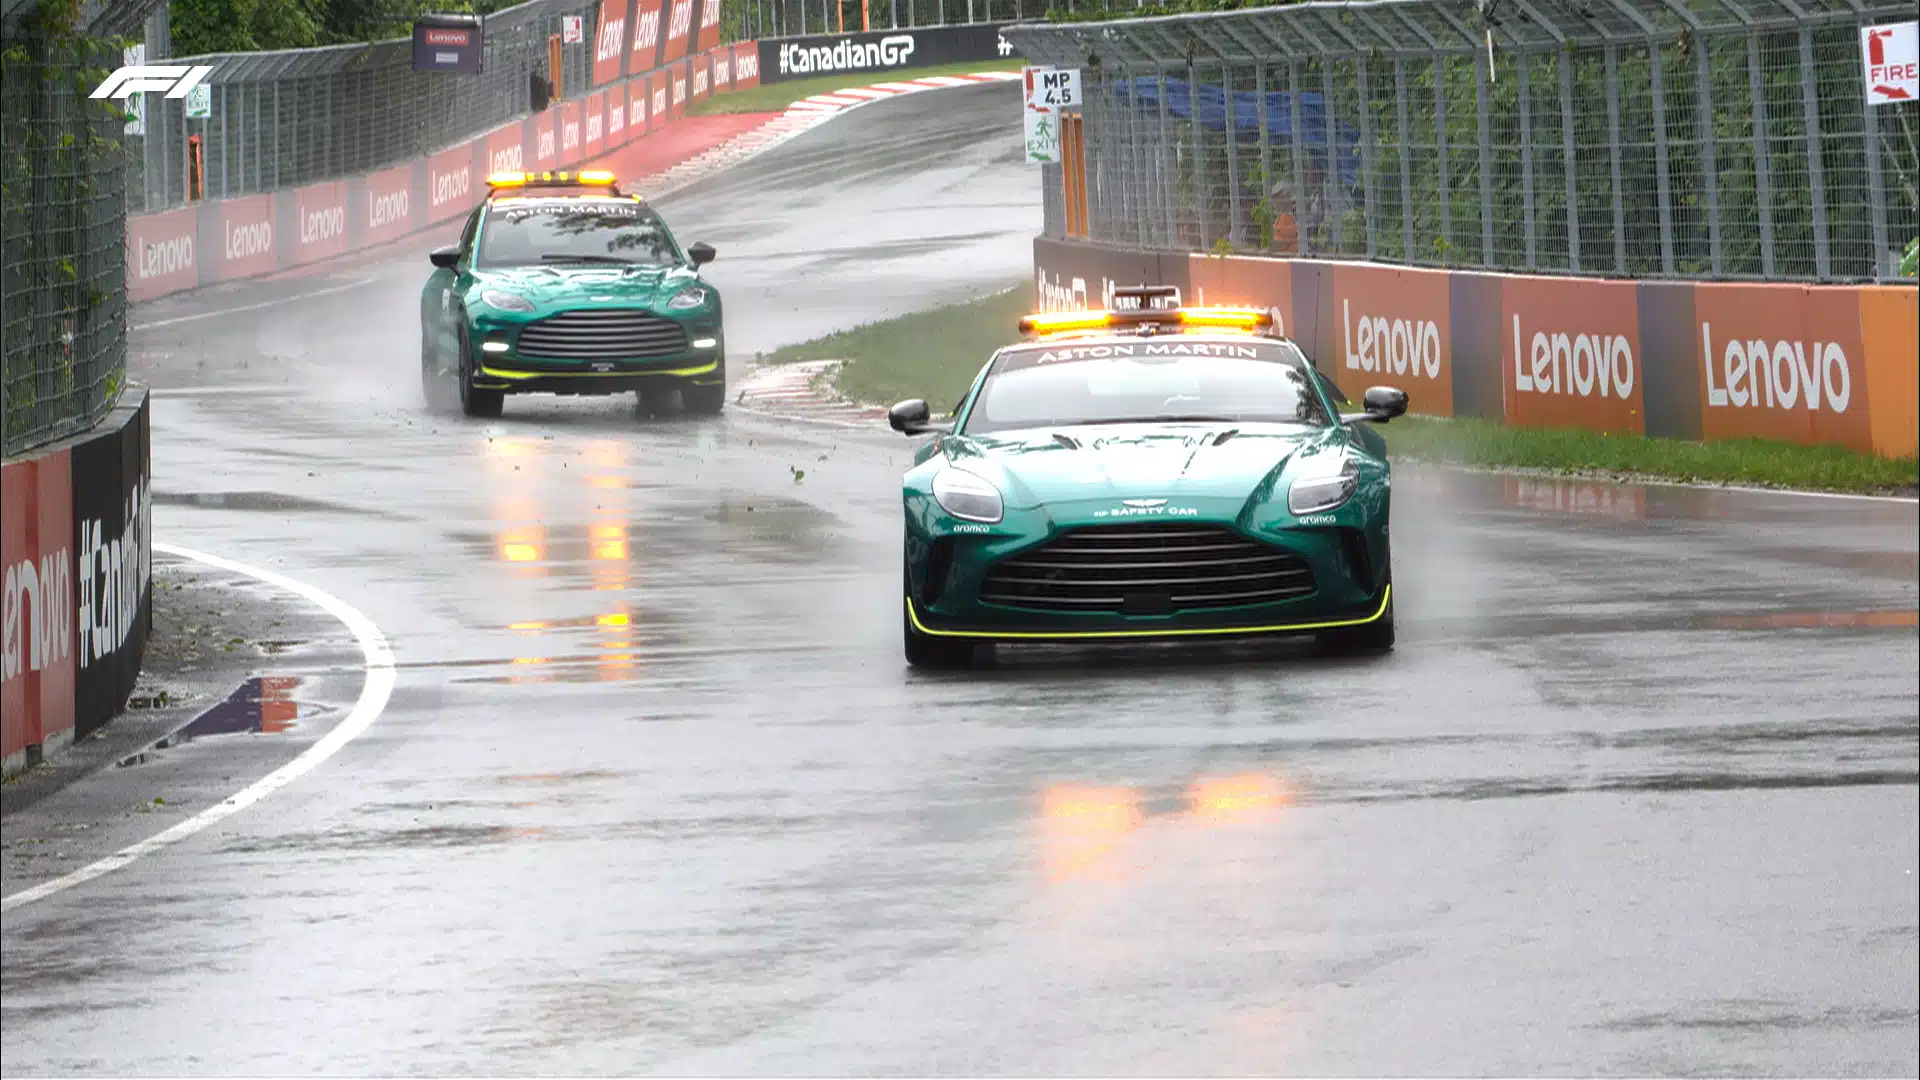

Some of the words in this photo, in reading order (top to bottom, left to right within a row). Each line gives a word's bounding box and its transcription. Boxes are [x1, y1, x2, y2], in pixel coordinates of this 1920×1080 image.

[429, 31, 466, 42] Lenovo
[736, 53, 758, 81] Lenovo
[779, 35, 915, 74] #CanadianGP
[1043, 72, 1070, 89] MP
[1871, 63, 1918, 84] FIRE
[1044, 88, 1072, 104] 4.5
[1027, 139, 1056, 151] EXIT
[432, 166, 469, 206] Lenovo
[301, 204, 344, 246] Lenovo
[369, 189, 408, 228] Lenovo
[138, 232, 193, 279] Lenovo
[225, 218, 271, 260] Lenovo
[1038, 345, 1134, 364] ASTON
[1145, 344, 1257, 359] MARTIN
[1343, 298, 1441, 380] Lenovo
[1513, 313, 1634, 400] Lenovo
[1702, 321, 1851, 414] Lenovo
[953, 524, 990, 533] aramco
[1110, 507, 1165, 517] SAFETY
[1168, 507, 1198, 516] CAR
[1299, 514, 1337, 525] aramco
[0, 546, 70, 683] enovo
